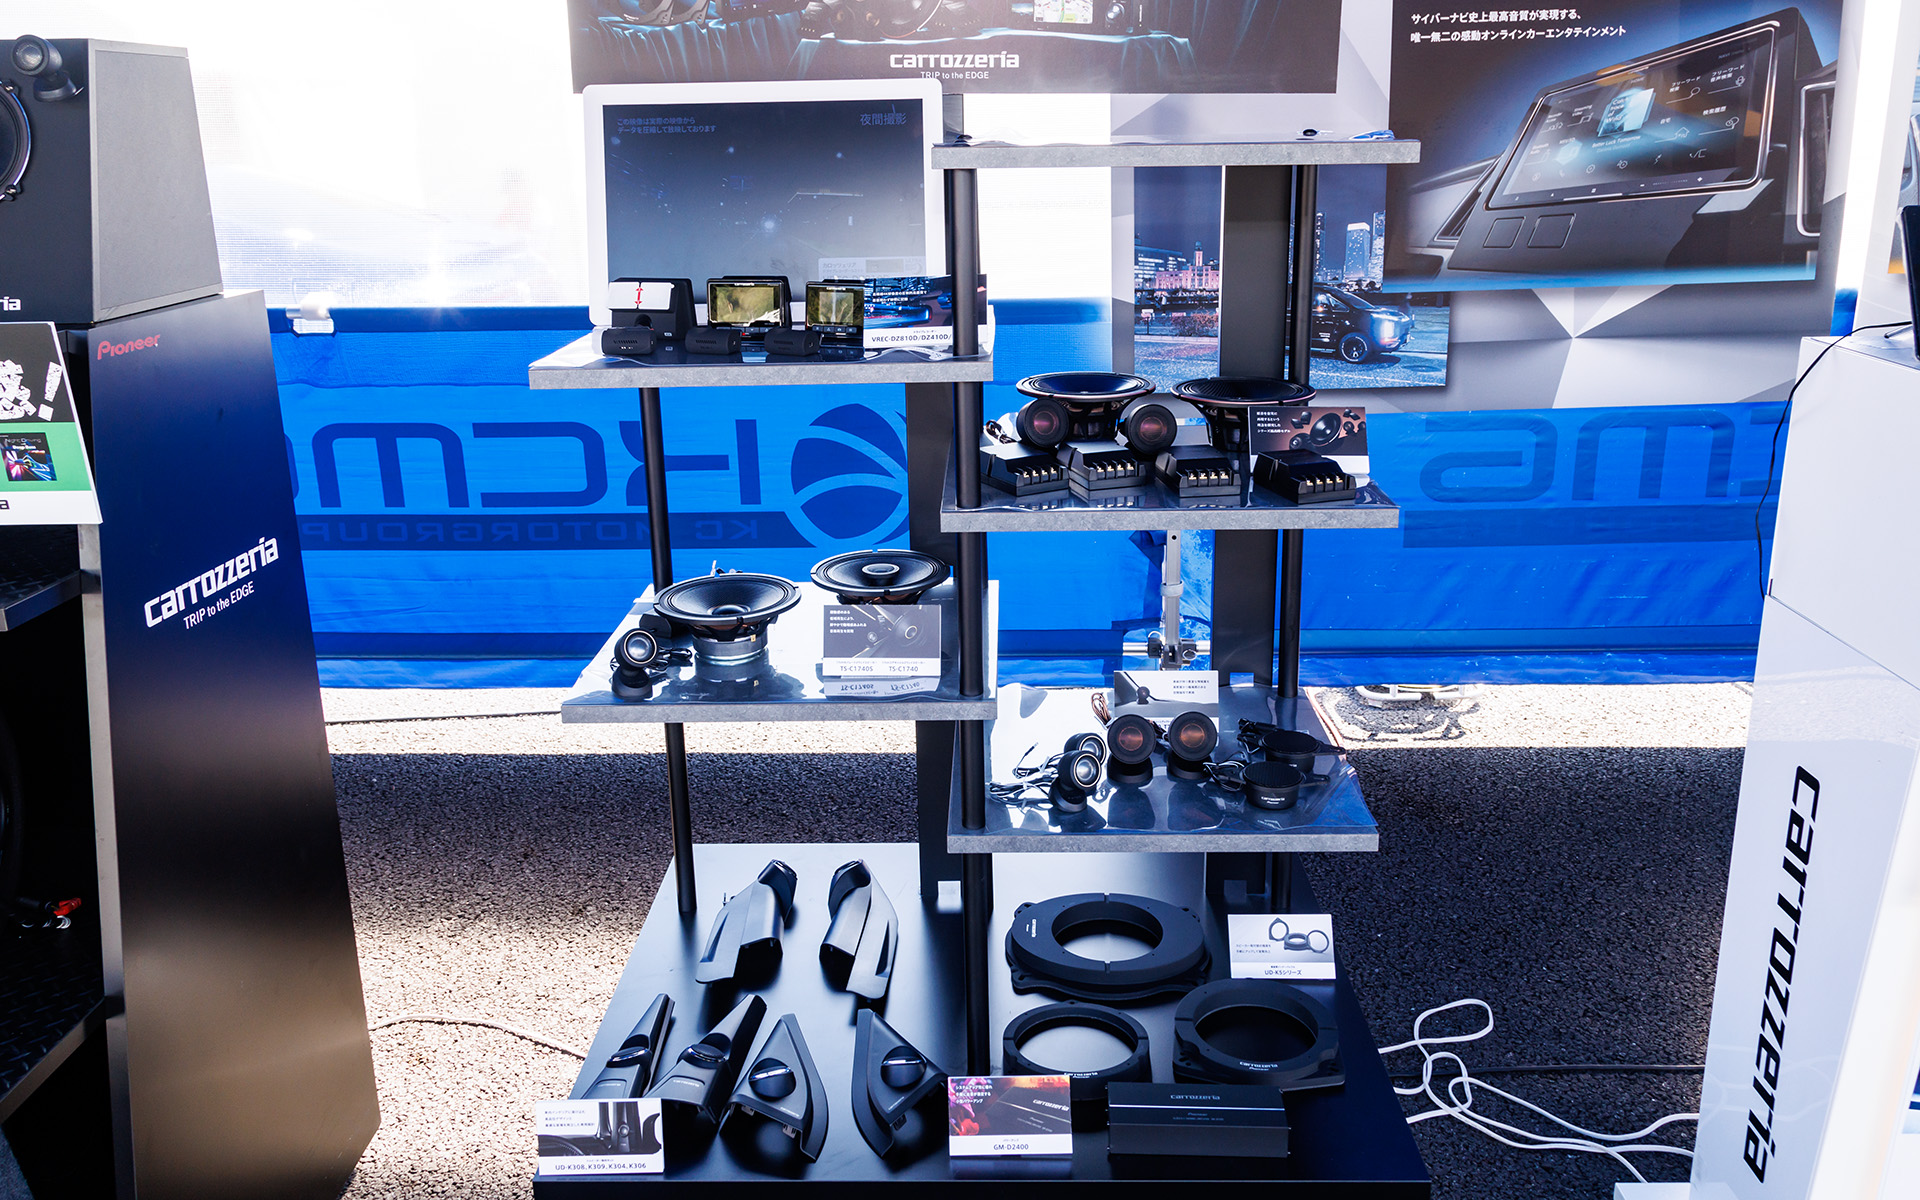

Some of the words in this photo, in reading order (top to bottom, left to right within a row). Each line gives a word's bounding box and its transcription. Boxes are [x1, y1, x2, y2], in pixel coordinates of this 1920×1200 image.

[1411, 9, 1582, 25] サイバーナビ史上最高音質が実現する、
[1410, 25, 1627, 43] 唯一無二の感動オンラインカーエンタテインメント
[921, 71, 940, 79] TRIP
[952, 71, 963, 79] the
[860, 113, 907, 126] 夜間撮影
[97, 334, 161, 361] Pioneer
[183, 608, 206, 630] TRIP
[207, 604, 217, 618] to
[216, 596, 230, 612] the
[230, 580, 255, 604] EDGE
[993, 1143, 1029, 1151] GM-D2400
